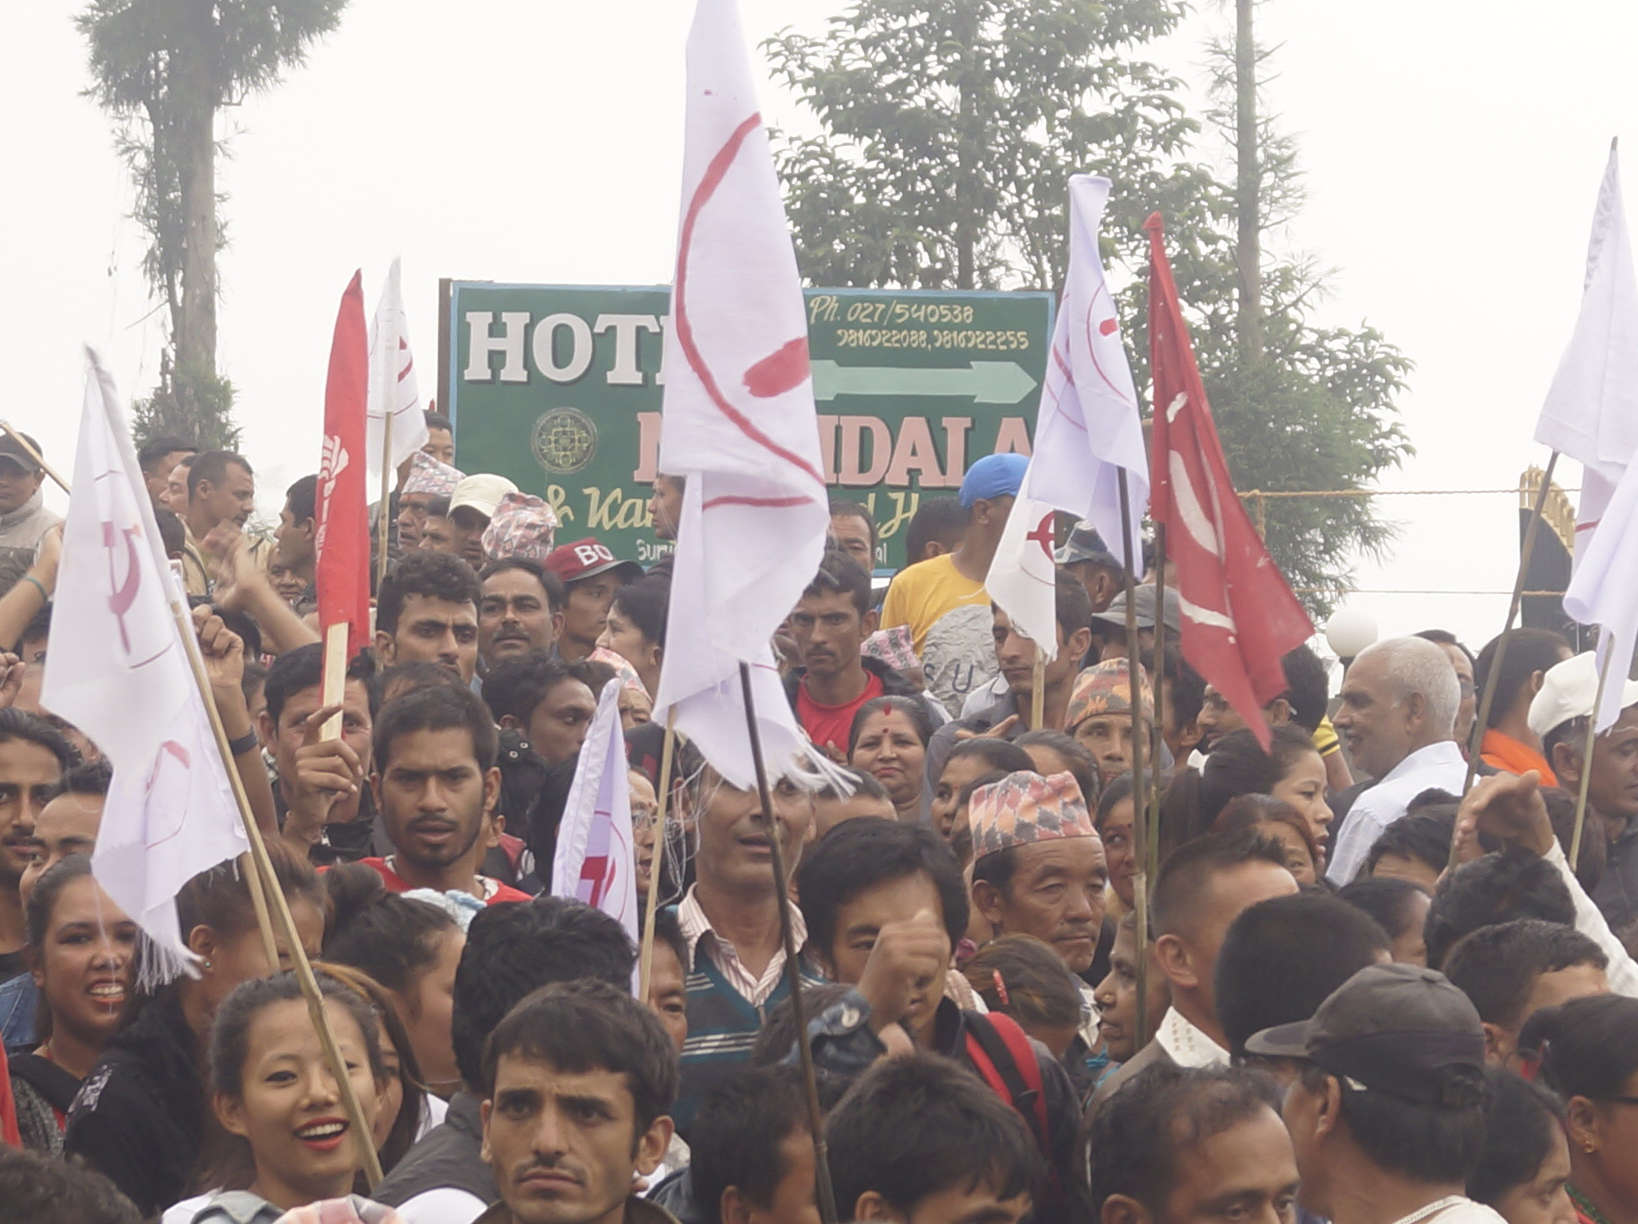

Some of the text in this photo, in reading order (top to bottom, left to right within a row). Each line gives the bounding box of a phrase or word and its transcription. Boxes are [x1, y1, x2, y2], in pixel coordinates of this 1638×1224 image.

[809, 296, 974, 326] Ph. 027/540538
[464, 311, 670, 386] HOT
